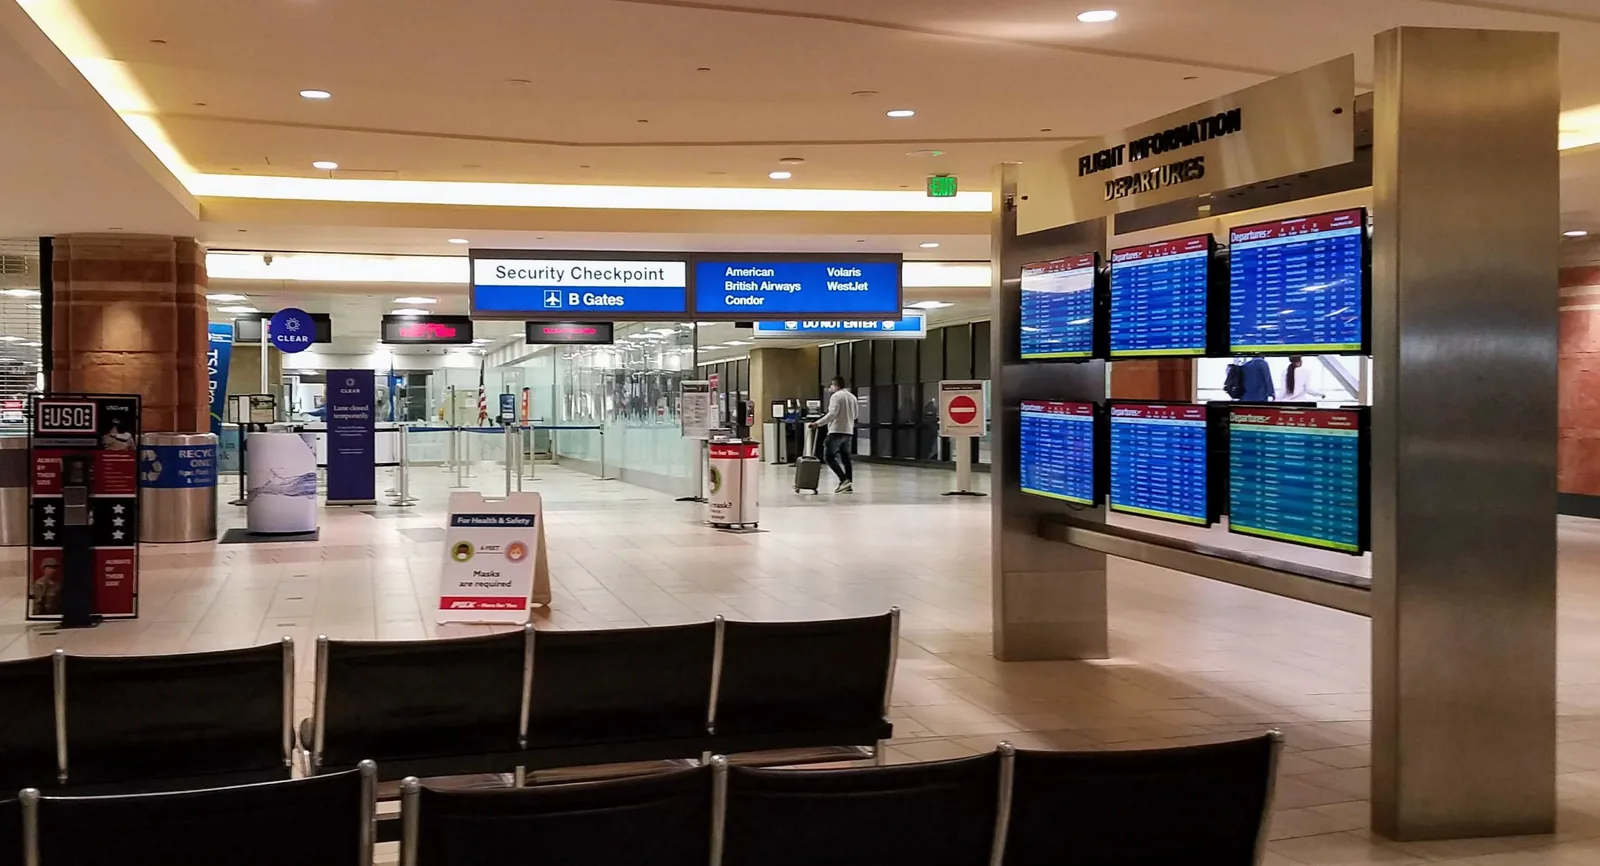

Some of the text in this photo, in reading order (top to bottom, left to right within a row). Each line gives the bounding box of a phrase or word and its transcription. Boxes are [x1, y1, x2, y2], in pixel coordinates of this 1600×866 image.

[1078, 107, 1242, 177] FLIGHT INFORMATION
[1103, 156, 1205, 201] DEPARTURES
[931, 177, 955, 196] EXIT
[1230, 230, 1267, 243] Departures
[1112, 250, 1140, 262] Departures
[495, 265, 665, 282] Security Checkpoint
[725, 266, 775, 277] American
[827, 267, 862, 277] Volaris
[725, 281, 802, 293] British Airways
[827, 281, 869, 292] WestJet
[568, 293, 625, 306] B Gates
[725, 295, 765, 306] Condor
[802, 321, 878, 329] DO NOT ENTER
[50, 407, 84, 427] USO
[333, 412, 369, 420] temporarily
[1230, 411, 1267, 423] Departures
[505, 517, 531, 525] Safety
[475, 580, 512, 588] required
